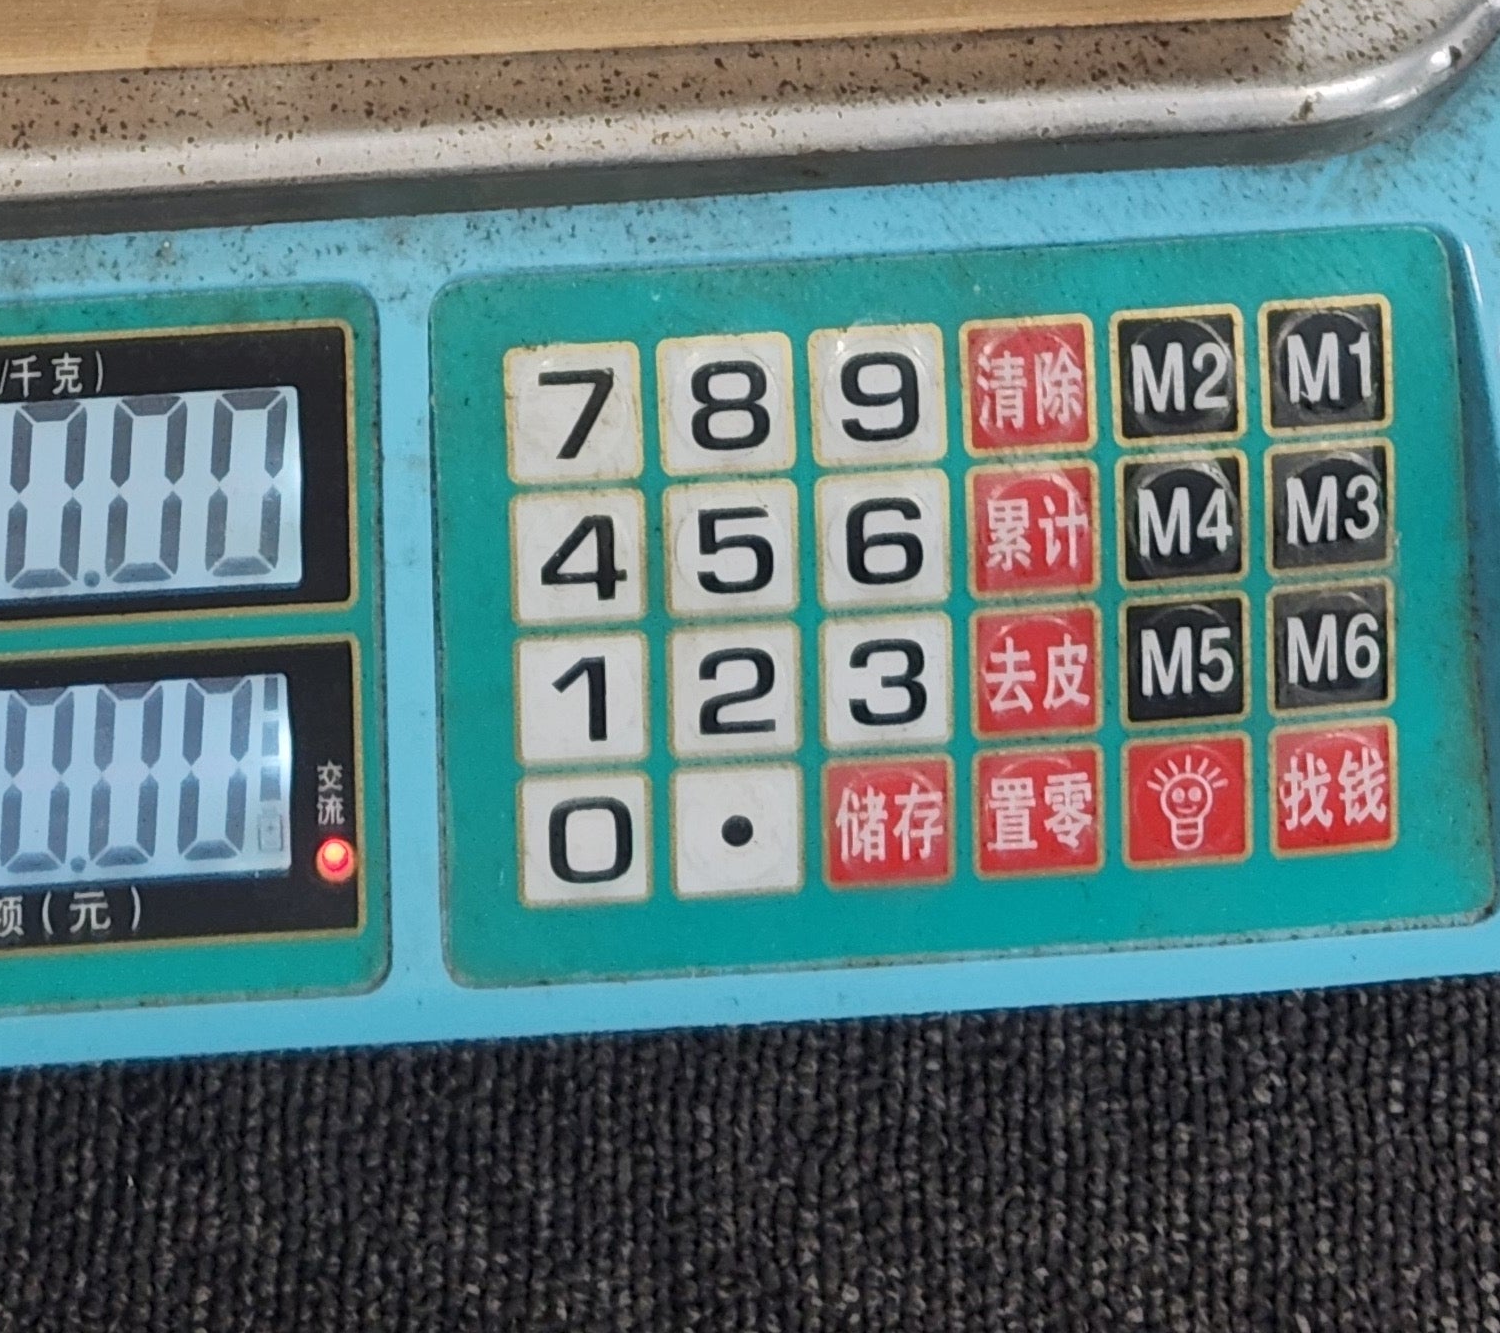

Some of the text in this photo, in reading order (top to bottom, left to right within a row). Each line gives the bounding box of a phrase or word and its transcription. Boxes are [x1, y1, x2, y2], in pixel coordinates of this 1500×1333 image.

[539, 329, 1373, 460] 7 8 9 清除 M2 M1
[4, 389, 287, 589] 0.00
[540, 474, 1382, 601] 4 5 6 累计 M4 M3
[552, 612, 1382, 743] 1 2 3 去皮 M5 M6
[0, 677, 254, 874] 0.00
[315, 758, 346, 826] 交流
[549, 797, 634, 884] 0
[835, 782, 944, 862] 储存
[987, 770, 1093, 854] 置零
[1280, 747, 1389, 834] 找钱
